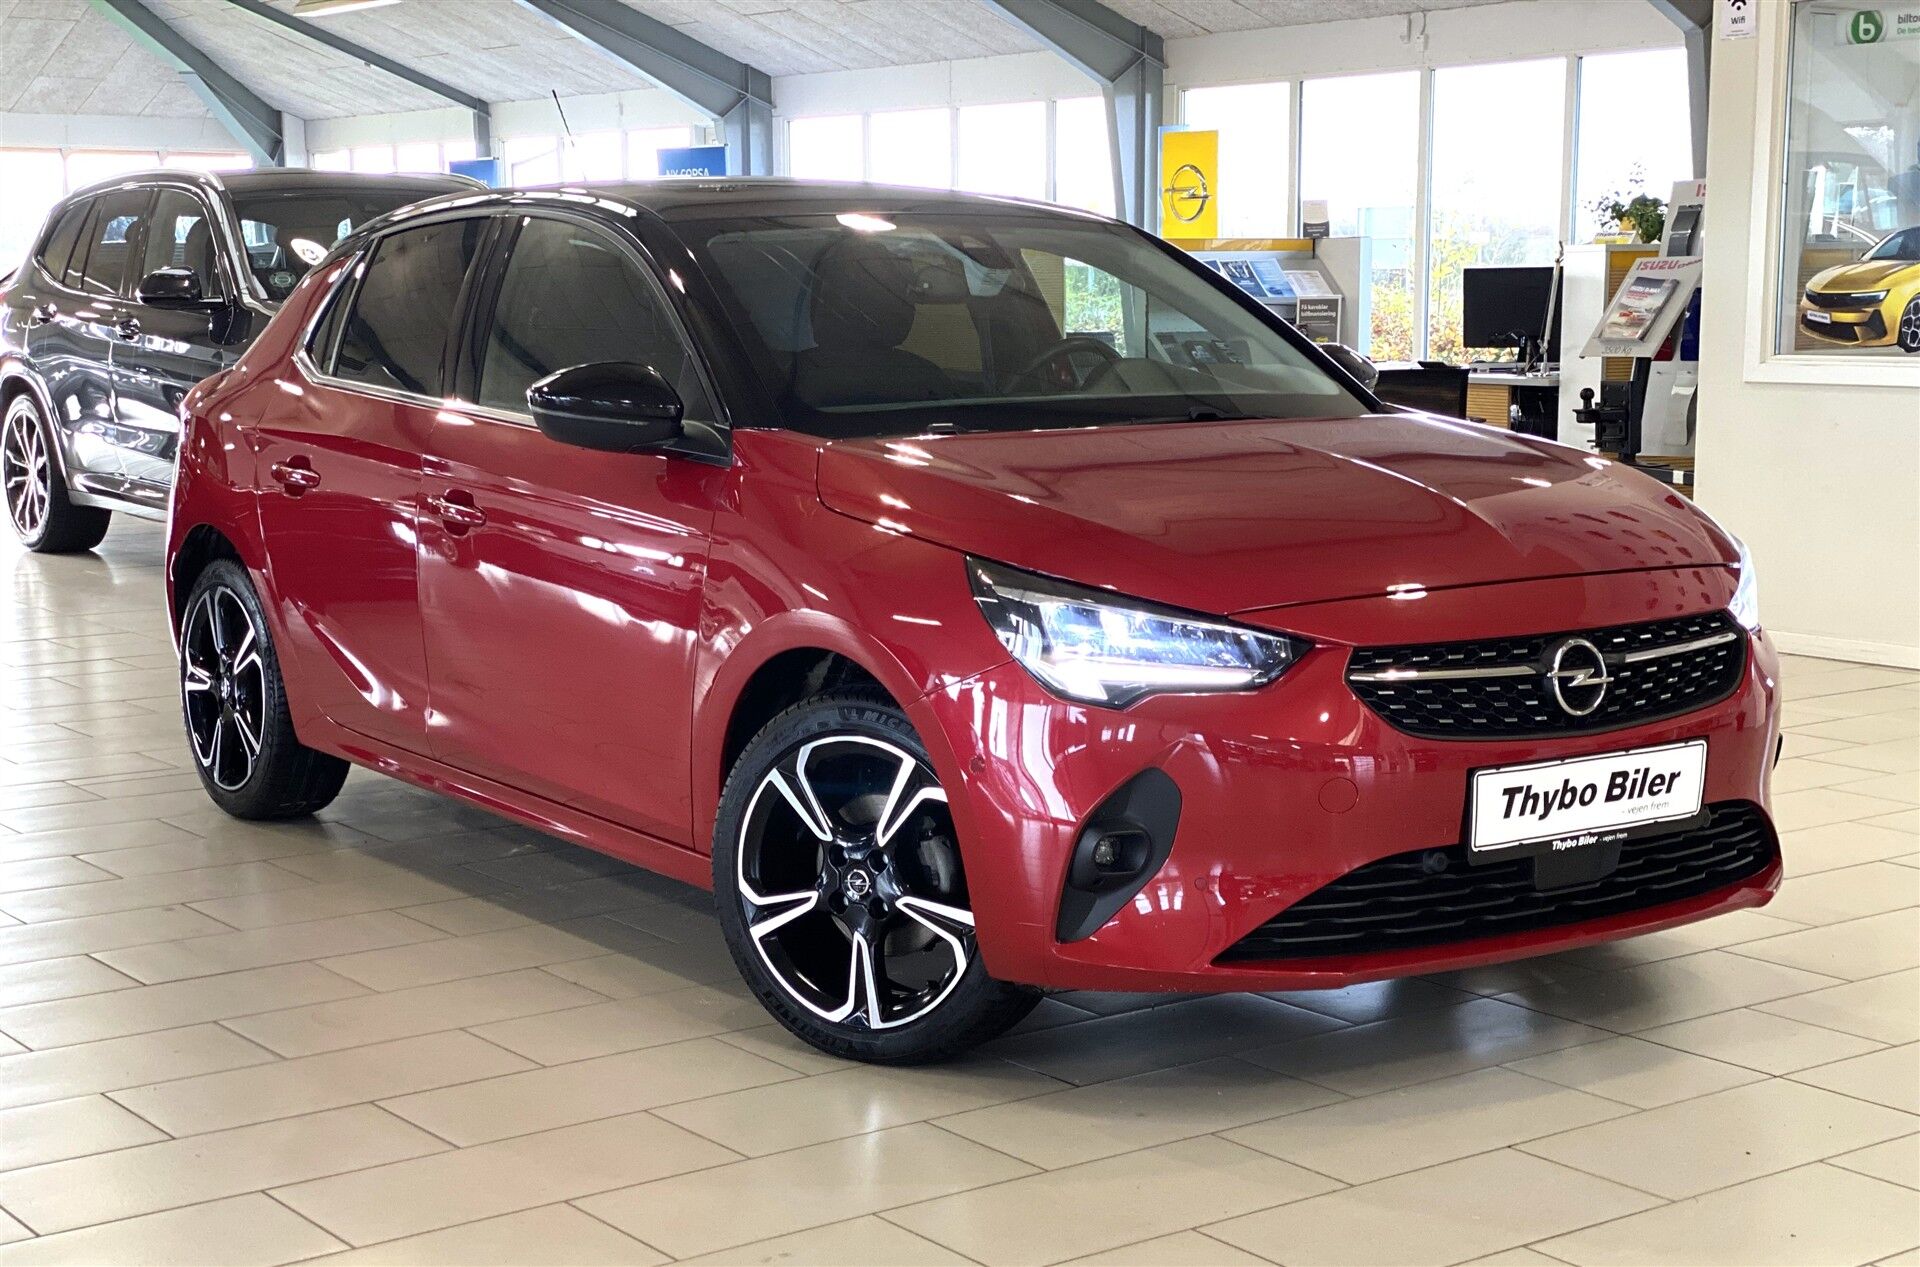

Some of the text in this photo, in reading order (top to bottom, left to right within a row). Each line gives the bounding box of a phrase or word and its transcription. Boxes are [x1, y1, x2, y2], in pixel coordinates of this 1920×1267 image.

[1731, 15, 1746, 25] Wifi
[1636, 259, 1679, 271] ISUZU
[1502, 767, 1681, 821] Thybo Biler
[1627, 805, 1649, 815] vejen
[1650, 801, 1670, 811] frem
[1552, 838, 1578, 851] Thybo
[1578, 835, 1598, 846] Biler
[1602, 834, 1615, 843] vejen
